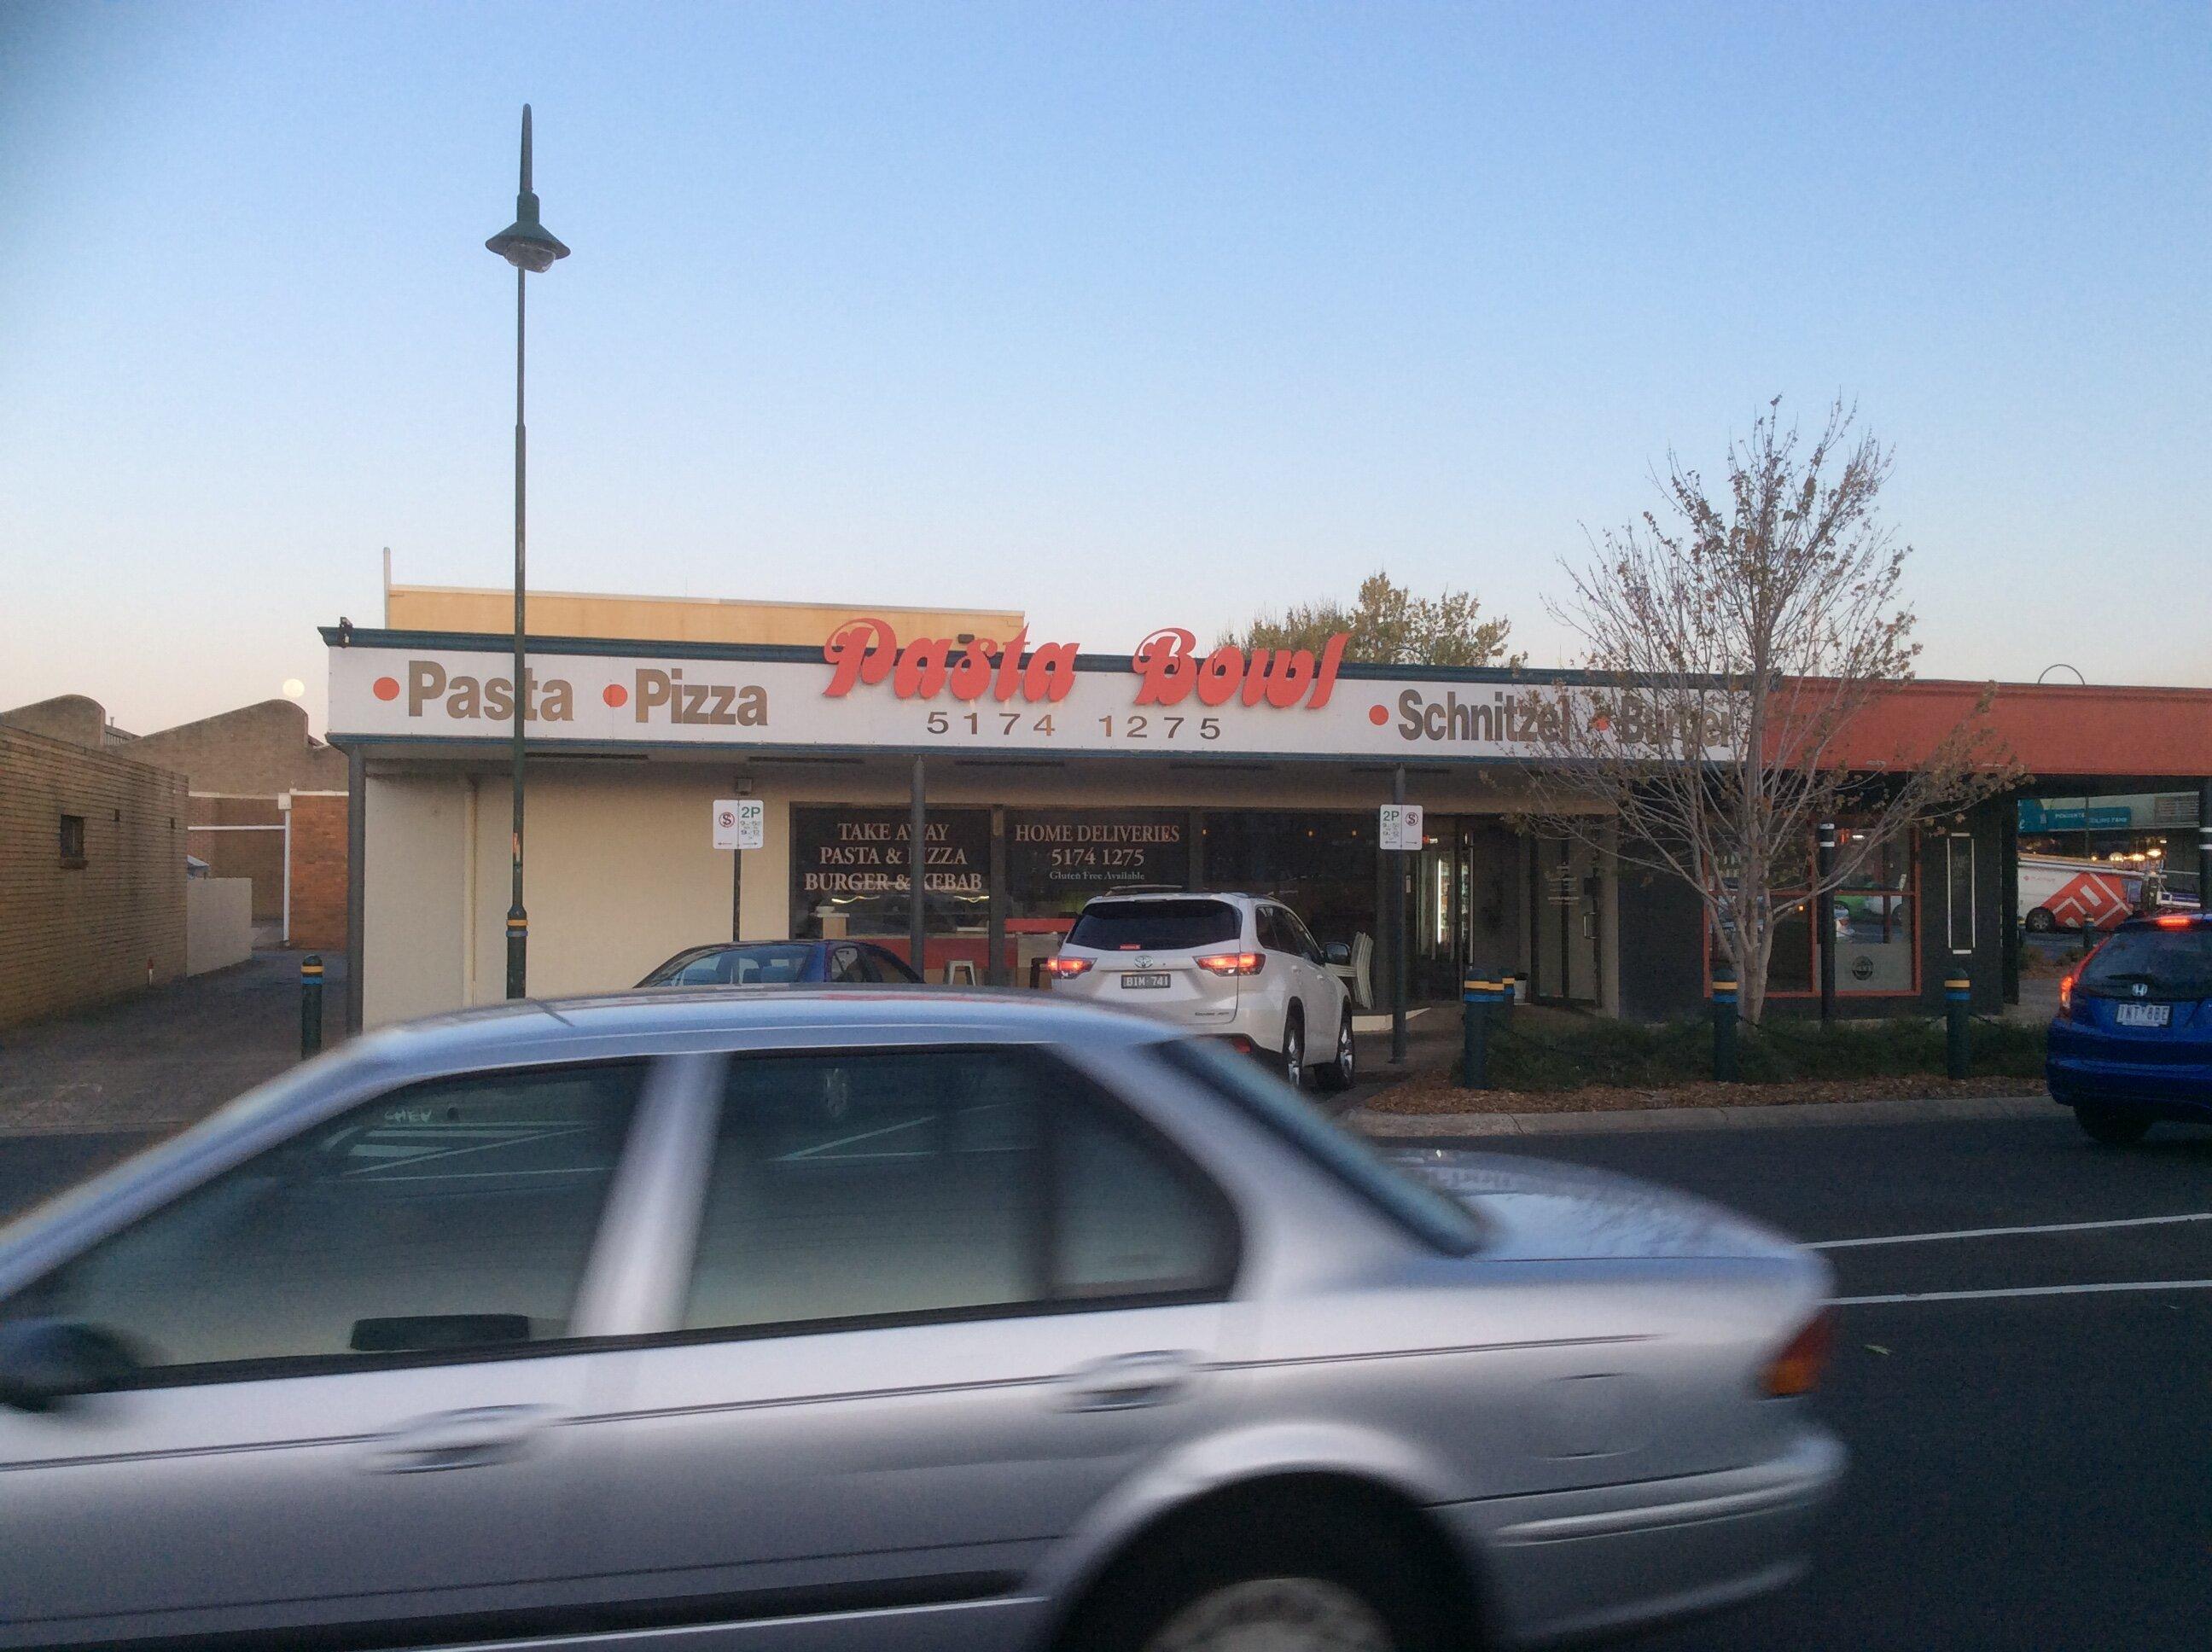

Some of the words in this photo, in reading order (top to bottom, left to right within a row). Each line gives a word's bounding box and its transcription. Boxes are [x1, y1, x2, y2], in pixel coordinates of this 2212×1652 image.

[823, 617, 1080, 703] Pasta
[1132, 627, 1353, 710] Bowl
[408, 660, 574, 722] Pasta
[635, 667, 769, 727] Pizza
[1398, 689, 1570, 743] Schnitzel
[927, 711, 1057, 736] 5174
[1098, 714, 1221, 740] 1275
[741, 806, 761, 818] 2P
[1382, 811, 1400, 821] 2P
[837, 823, 891, 841] TAKE
[1015, 824, 1074, 842] HOME
[1077, 824, 1180, 842] DELIVERIES
[819, 846, 881, 864] PASTA
[885, 846, 903, 864] &
[907, 846, 968, 864] ZZA
[1051, 847, 1097, 866] 5174
[1102, 848, 1145, 866] 1275
[804, 872, 890, 890] BURGER
[894, 873, 911, 890] &
[1049, 870, 1081, 880] Gluten
[1083, 870, 1103, 880] Free
[1103, 870, 1145, 880] Available
